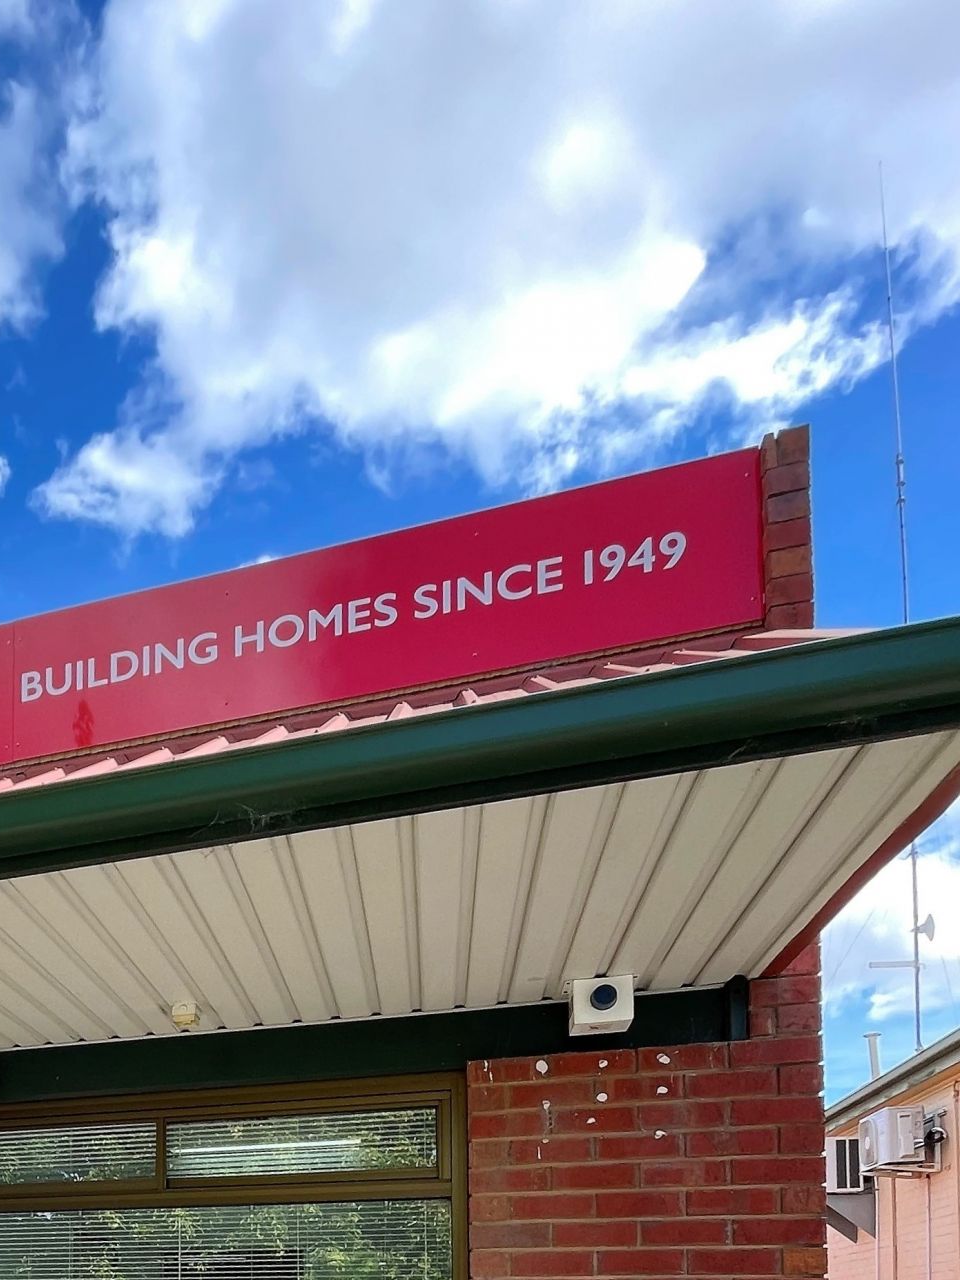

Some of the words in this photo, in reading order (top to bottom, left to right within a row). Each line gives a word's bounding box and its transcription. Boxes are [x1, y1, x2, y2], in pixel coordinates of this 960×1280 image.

[20, 631, 218, 703] BUILDING
[234, 592, 397, 657] HOMES
[414, 556, 563, 620] SINCE
[583, 531, 687, 586] 1949
